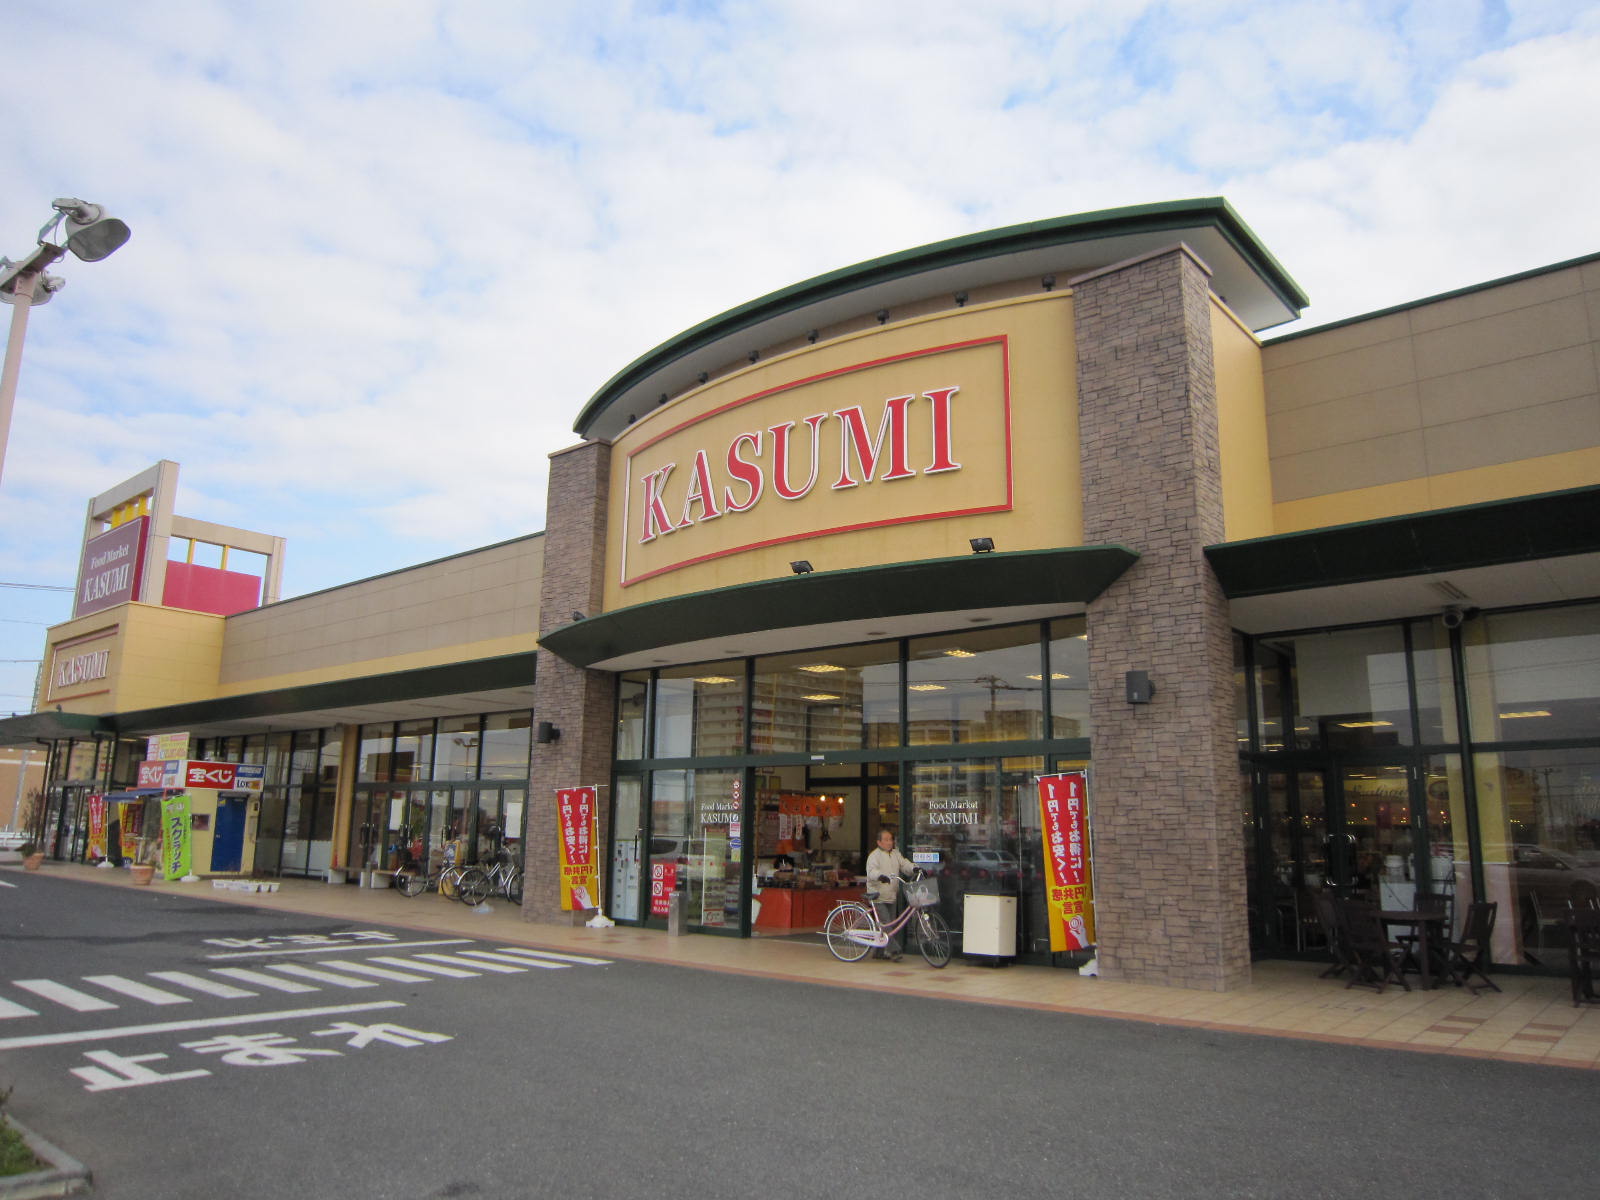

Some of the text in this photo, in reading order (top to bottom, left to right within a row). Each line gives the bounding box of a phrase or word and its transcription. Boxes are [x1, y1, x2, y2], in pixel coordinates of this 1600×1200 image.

[638, 385, 962, 544] KASUMI
[91, 544, 129, 570] Food Market
[82, 563, 130, 603] KASUMI
[57, 648, 110, 689] KASUMI
[189, 767, 233, 783] 宝くじ
[701, 802, 715, 811] Food
[929, 800, 978, 809] Food Market
[701, 812, 733, 824] KASUM
[928, 812, 979, 825] KASUMI
[69, 1022, 455, 1092] 止まれ
